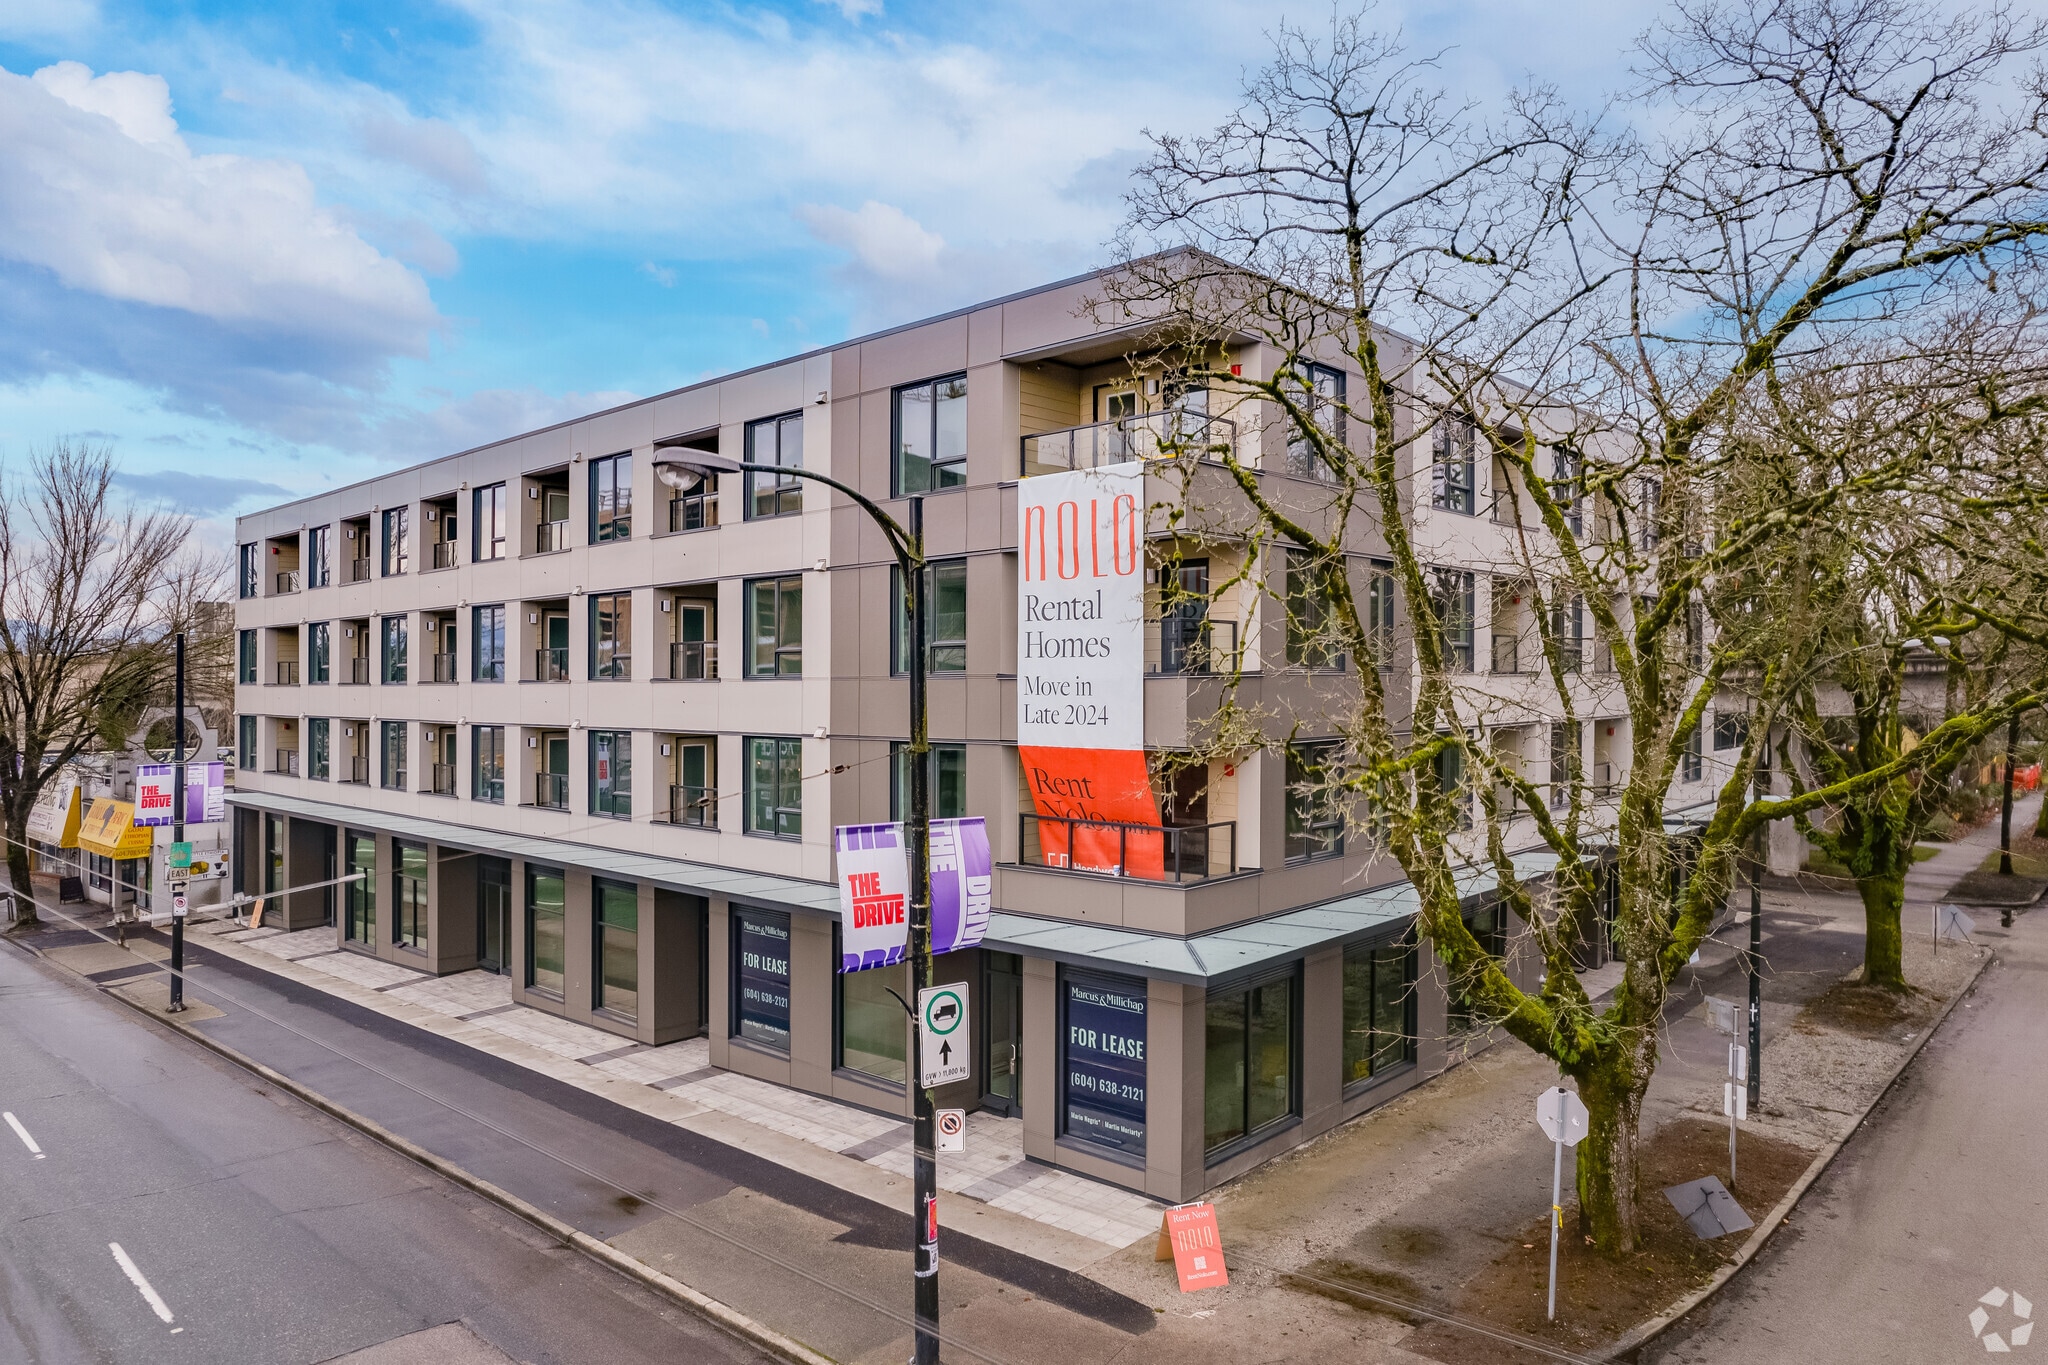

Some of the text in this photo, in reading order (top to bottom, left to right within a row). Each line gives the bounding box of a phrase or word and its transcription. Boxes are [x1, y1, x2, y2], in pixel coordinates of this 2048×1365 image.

[1025, 589, 1103, 622] Rental
[1025, 631, 1111, 659] Homes
[1024, 675, 1093, 696] Move in
[1024, 703, 1109, 726] Late 2024
[141, 786, 159, 796] THE
[1031, 767, 1097, 800] Rent
[141, 798, 172, 809] DRIVE
[1040, 800, 1151, 835] Nolo.com
[929, 820, 958, 872] THE
[171, 869, 188, 878] EAST
[848, 872, 881, 898] THE
[853, 901, 905, 929] DRIVE
[744, 921, 761, 932] Marcus
[765, 925, 788, 940] Millichap
[744, 952, 788, 976] FOR LEASE
[744, 987, 788, 1009] (604) 638-2121
[1072, 987, 1099, 1002] Marcus
[1107, 994, 1144, 1013] Millichap
[1071, 1026, 1144, 1060] FOR LEASE
[925, 1073, 937, 1081] GVW
[1071, 1072, 1144, 1102] (604) 638-2121
[1071, 1111, 1083, 1121] Mario
[1105, 1121, 1120, 1132] Martin
[1173, 1210, 1210, 1223] Rent Now
